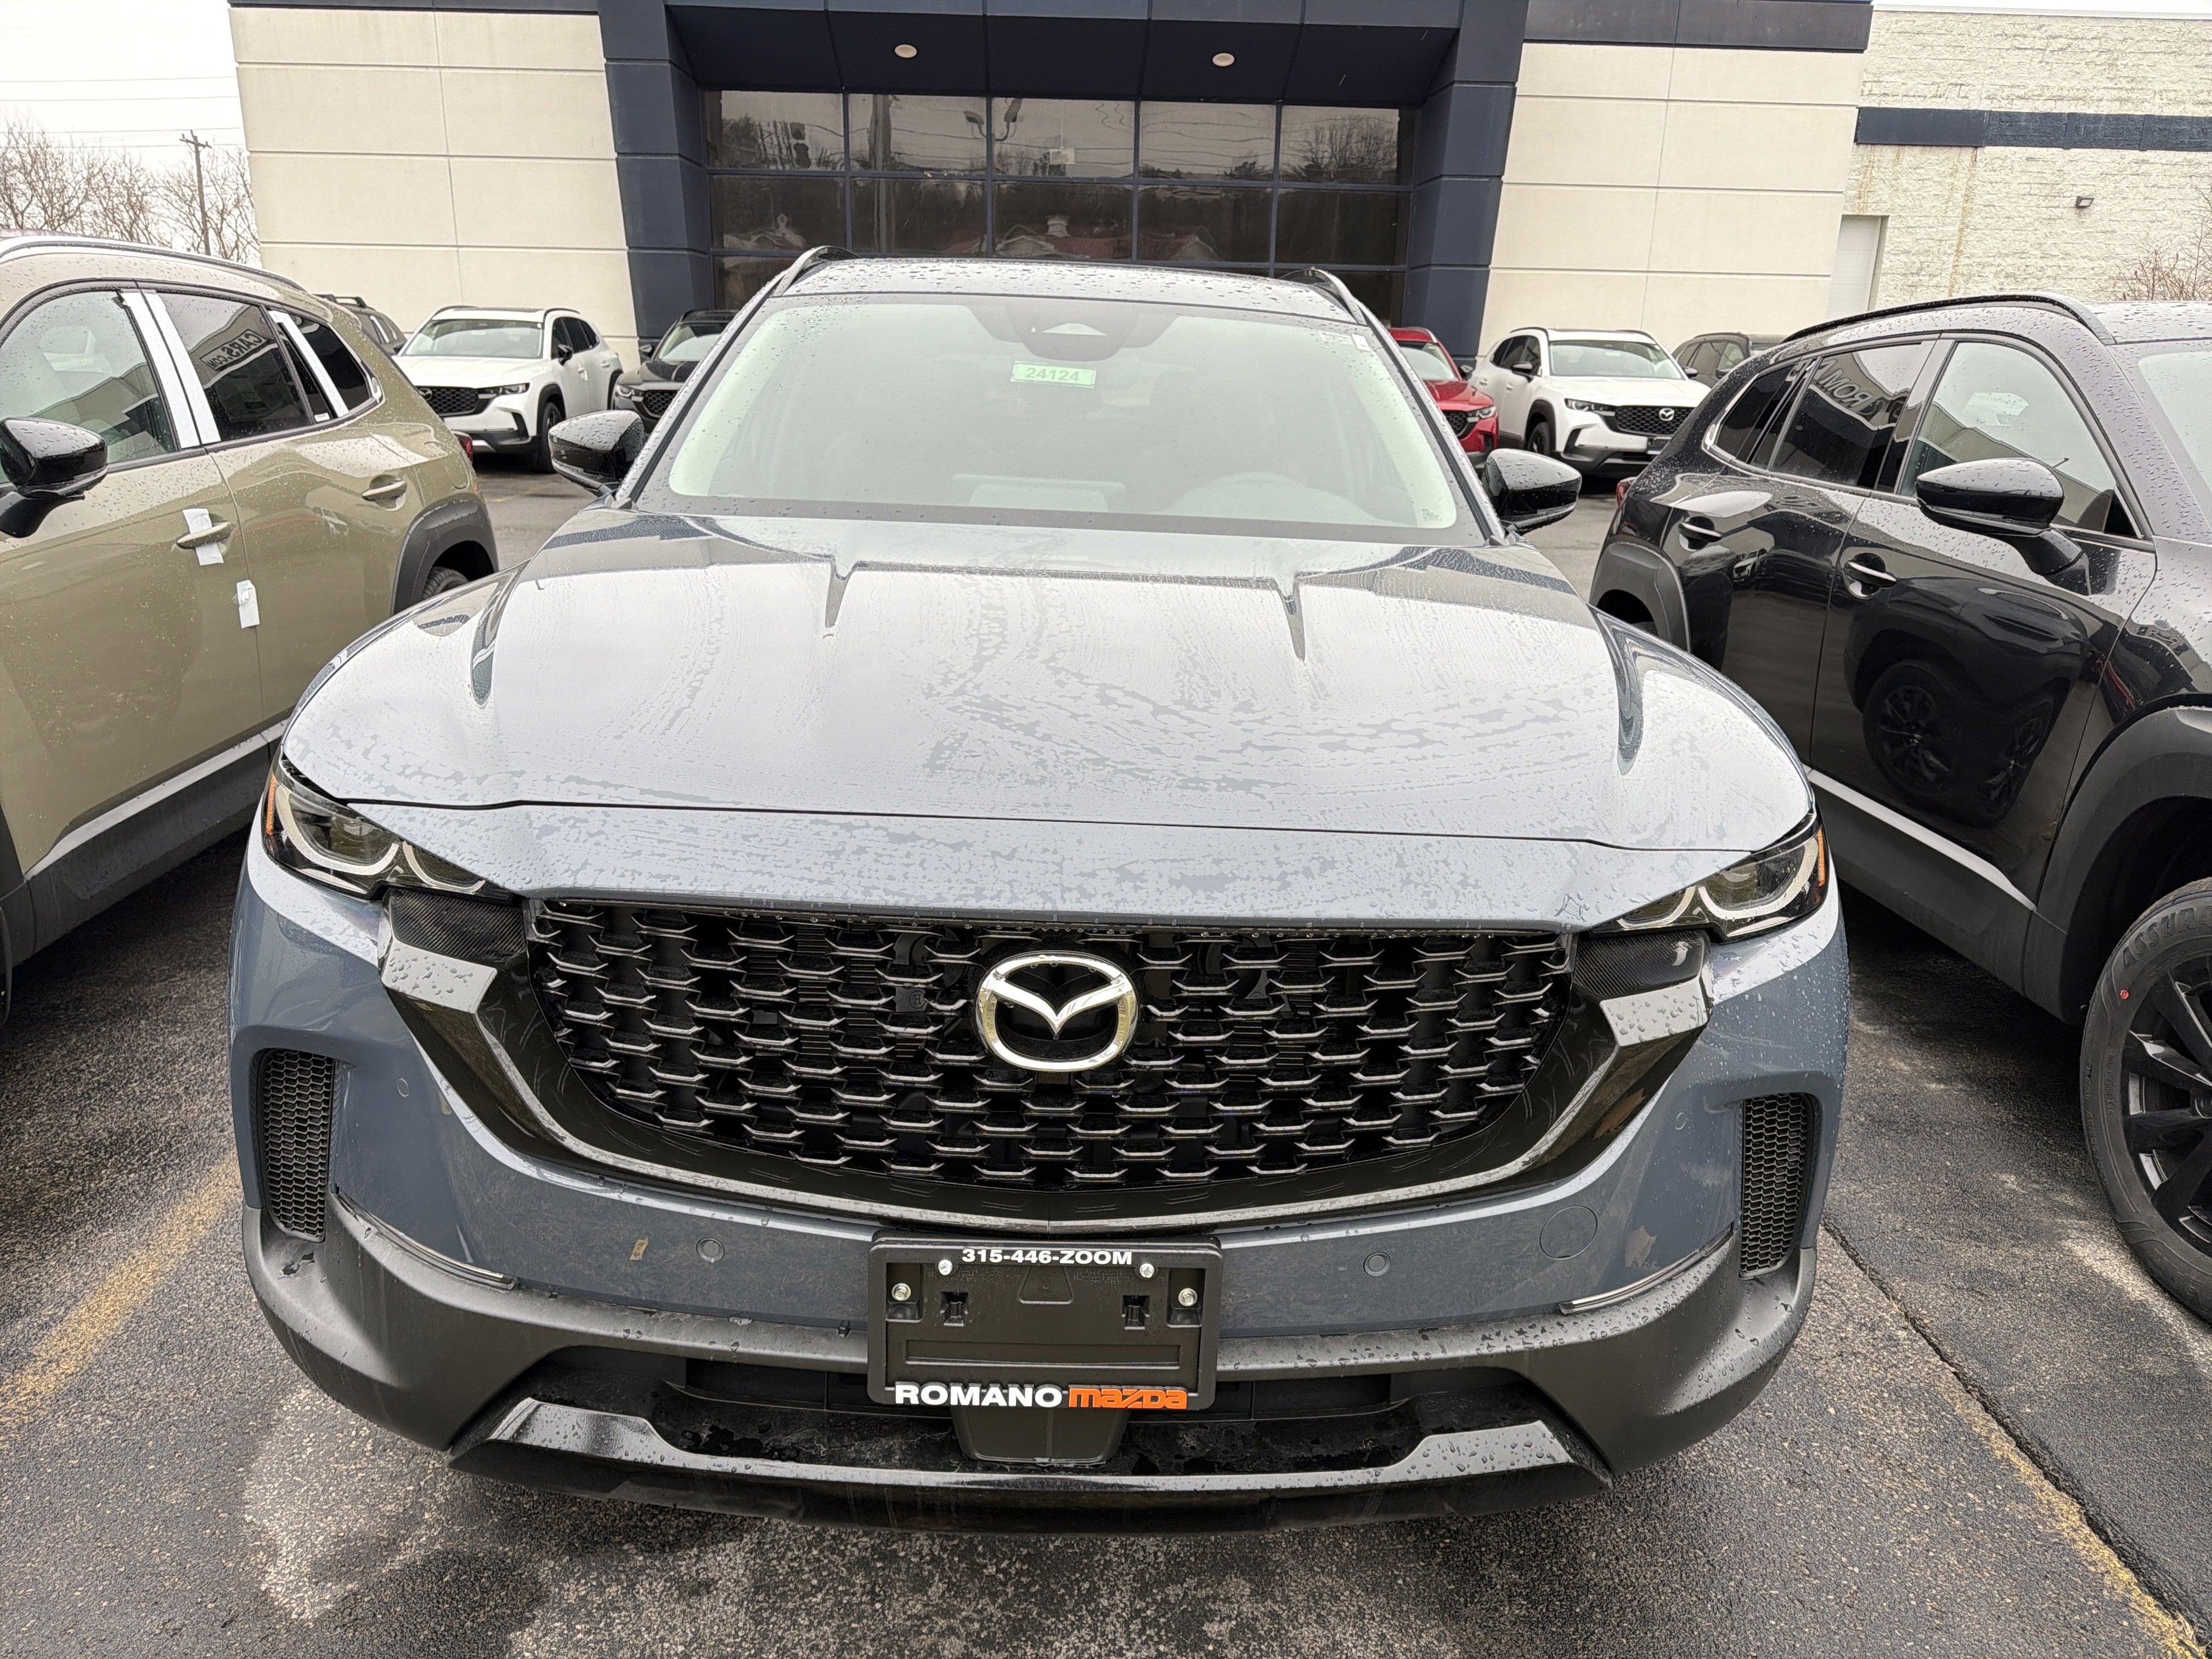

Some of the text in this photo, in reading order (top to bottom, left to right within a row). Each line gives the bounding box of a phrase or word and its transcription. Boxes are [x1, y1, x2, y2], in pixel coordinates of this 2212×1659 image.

[1025, 367, 1080, 382] 24124
[962, 1249, 1132, 1265] 315-446-ZOOM
[895, 1384, 1188, 1409] ROMANO mazda
